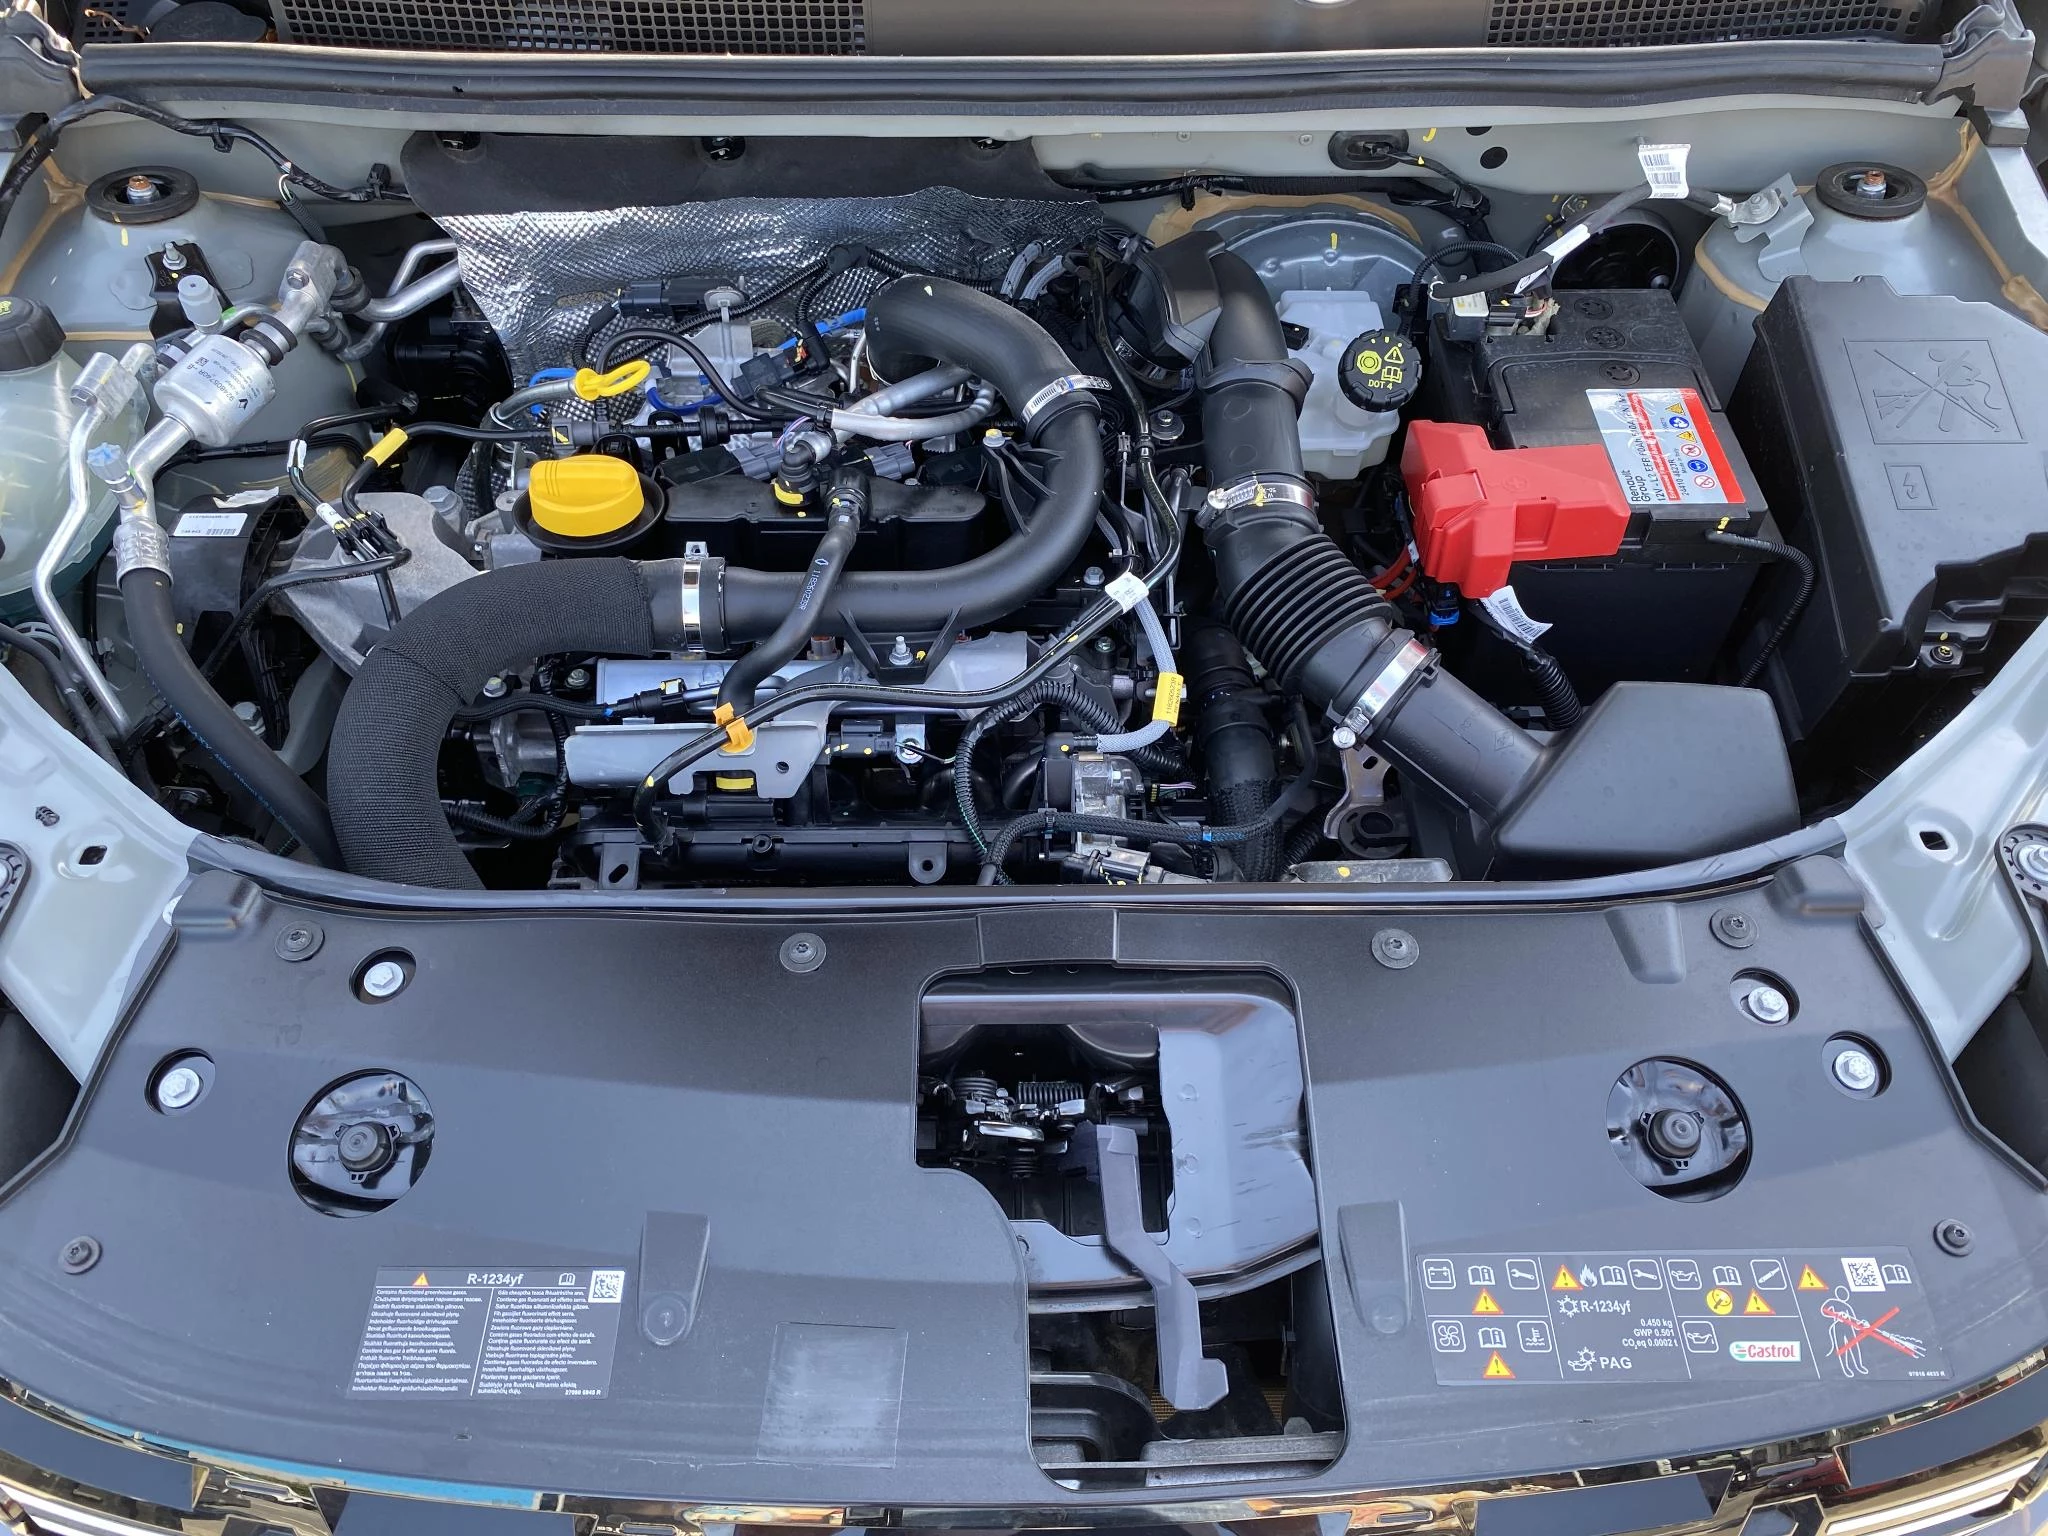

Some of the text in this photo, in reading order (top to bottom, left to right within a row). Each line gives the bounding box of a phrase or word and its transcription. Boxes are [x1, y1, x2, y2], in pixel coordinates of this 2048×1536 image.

[1368, 379, 1385, 389] DOT
[1642, 457, 1654, 472] EFB
[1621, 470, 1641, 502] Renault
[1635, 476, 1651, 502] Group
[1654, 488, 1666, 501] 12V
[467, 1273, 524, 1286] R-1234yf
[1581, 1300, 1631, 1315] R-1234yf
[1663, 1319, 1673, 1328] kg
[1748, 1344, 1796, 1358] Castrol
[1600, 1357, 1632, 1369] PAG
